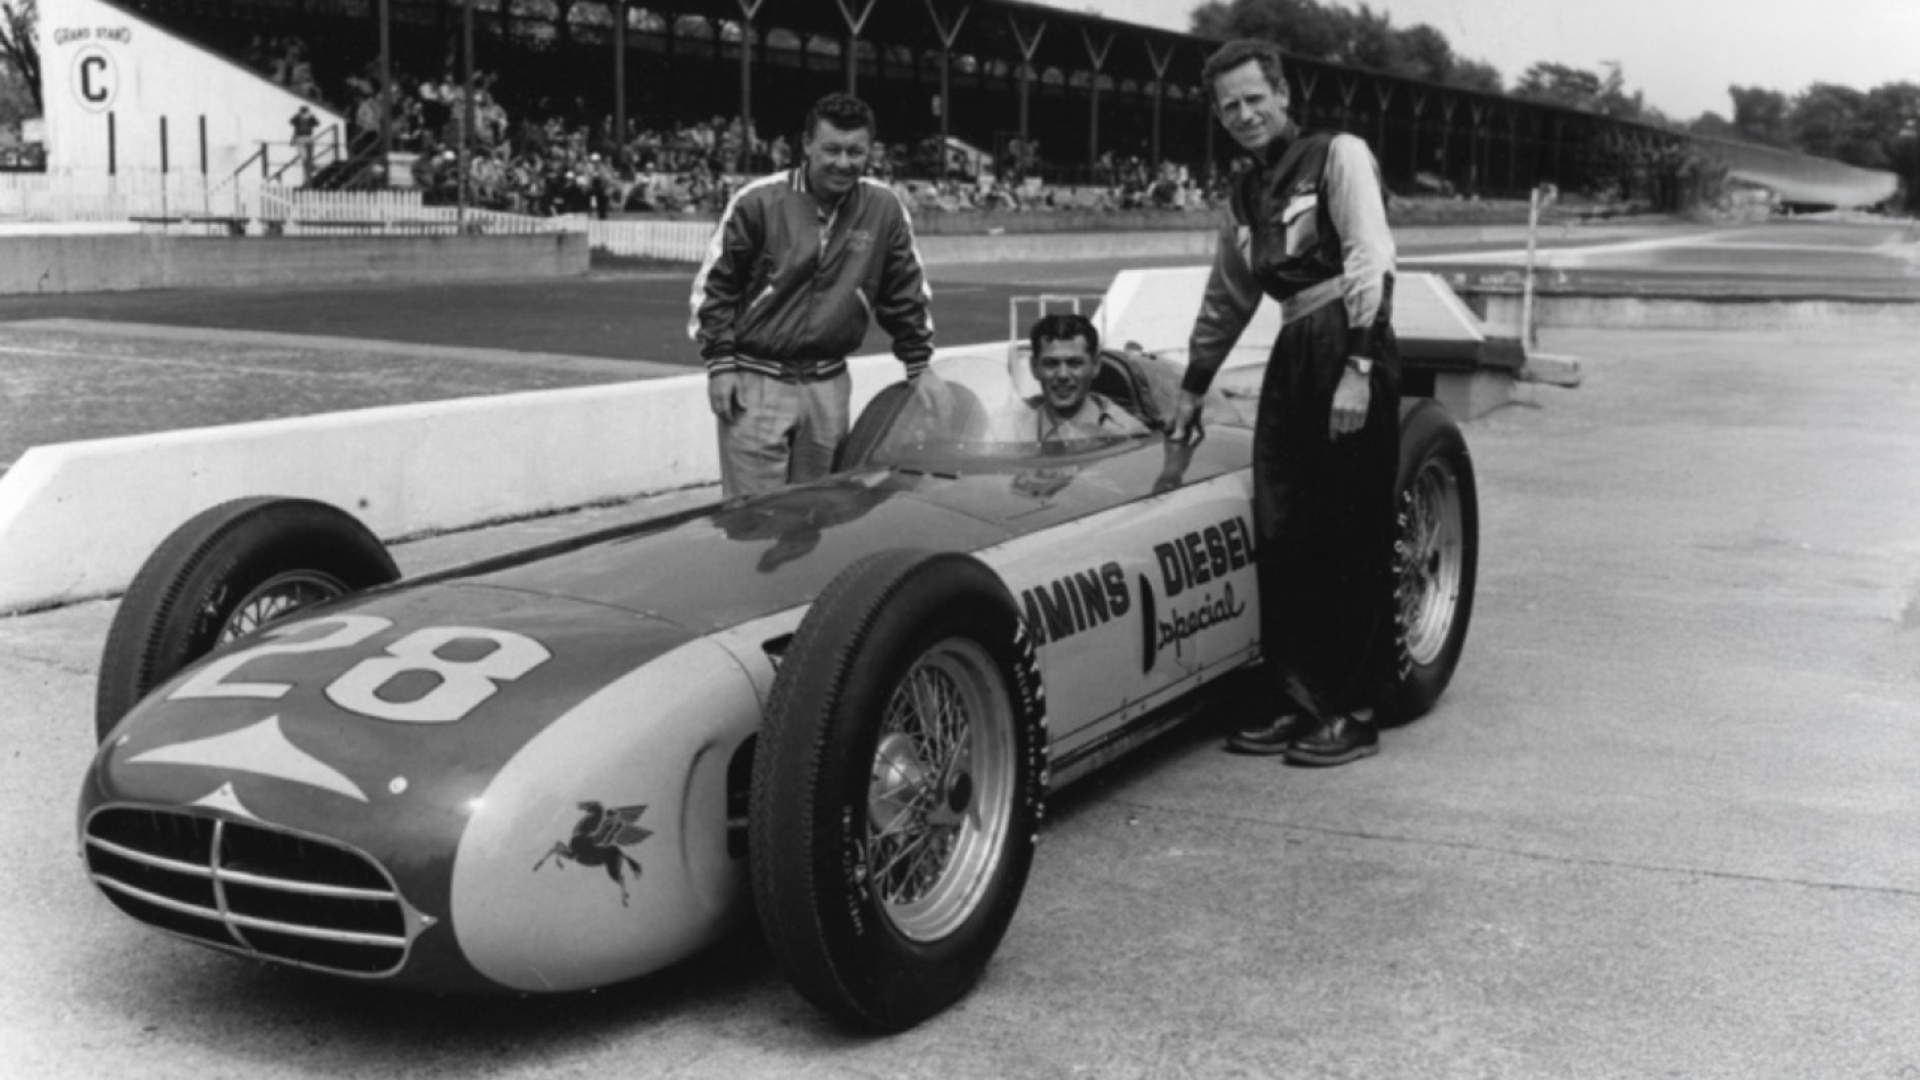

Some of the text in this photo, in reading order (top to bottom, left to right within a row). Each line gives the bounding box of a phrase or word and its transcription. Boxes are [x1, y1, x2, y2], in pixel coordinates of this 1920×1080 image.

[54, 26, 131, 45] GRAND STAND
[81, 55, 107, 102] C
[1153, 516, 1257, 598] DIESEL
[166, 614, 554, 723] 28
